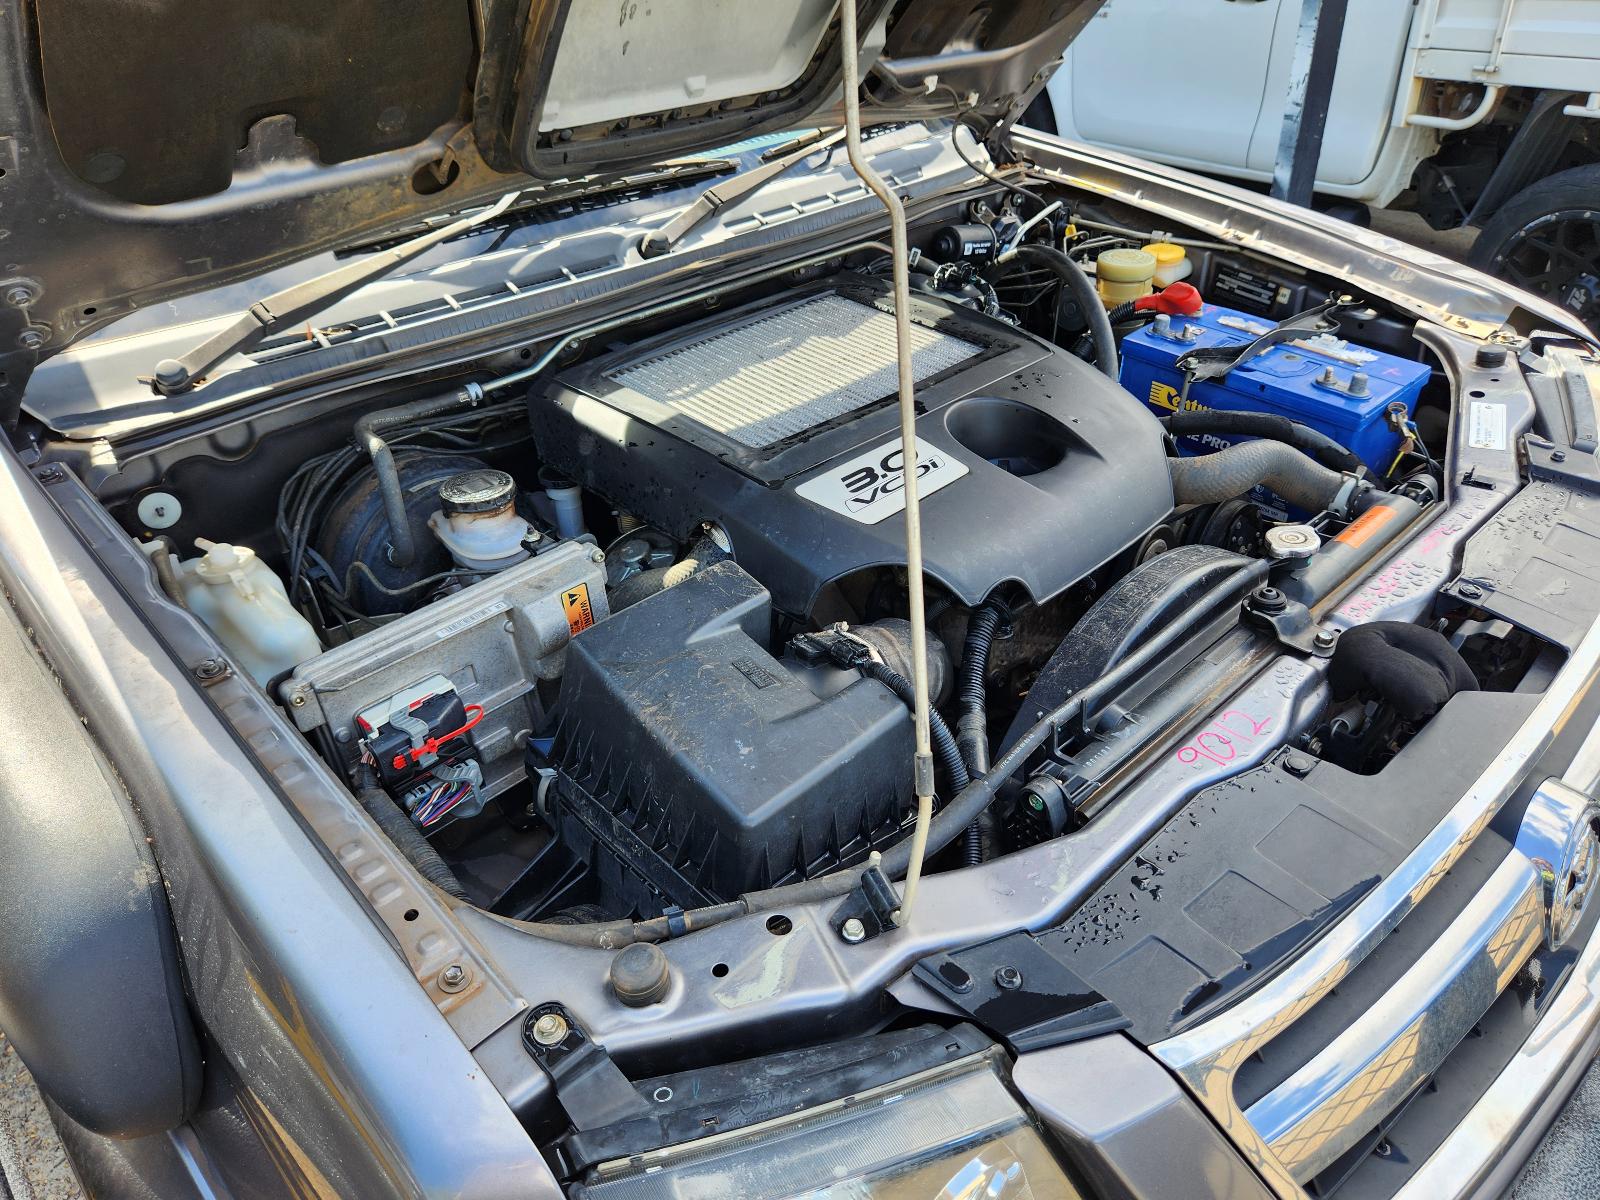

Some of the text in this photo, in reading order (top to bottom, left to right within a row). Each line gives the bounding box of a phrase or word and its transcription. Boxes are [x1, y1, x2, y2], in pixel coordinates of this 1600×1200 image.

[1201, 434, 1231, 450] PRO
[841, 449, 919, 493] 3.0
[580, 599, 593, 629] WARNI
[1177, 710, 1272, 767] 9012
